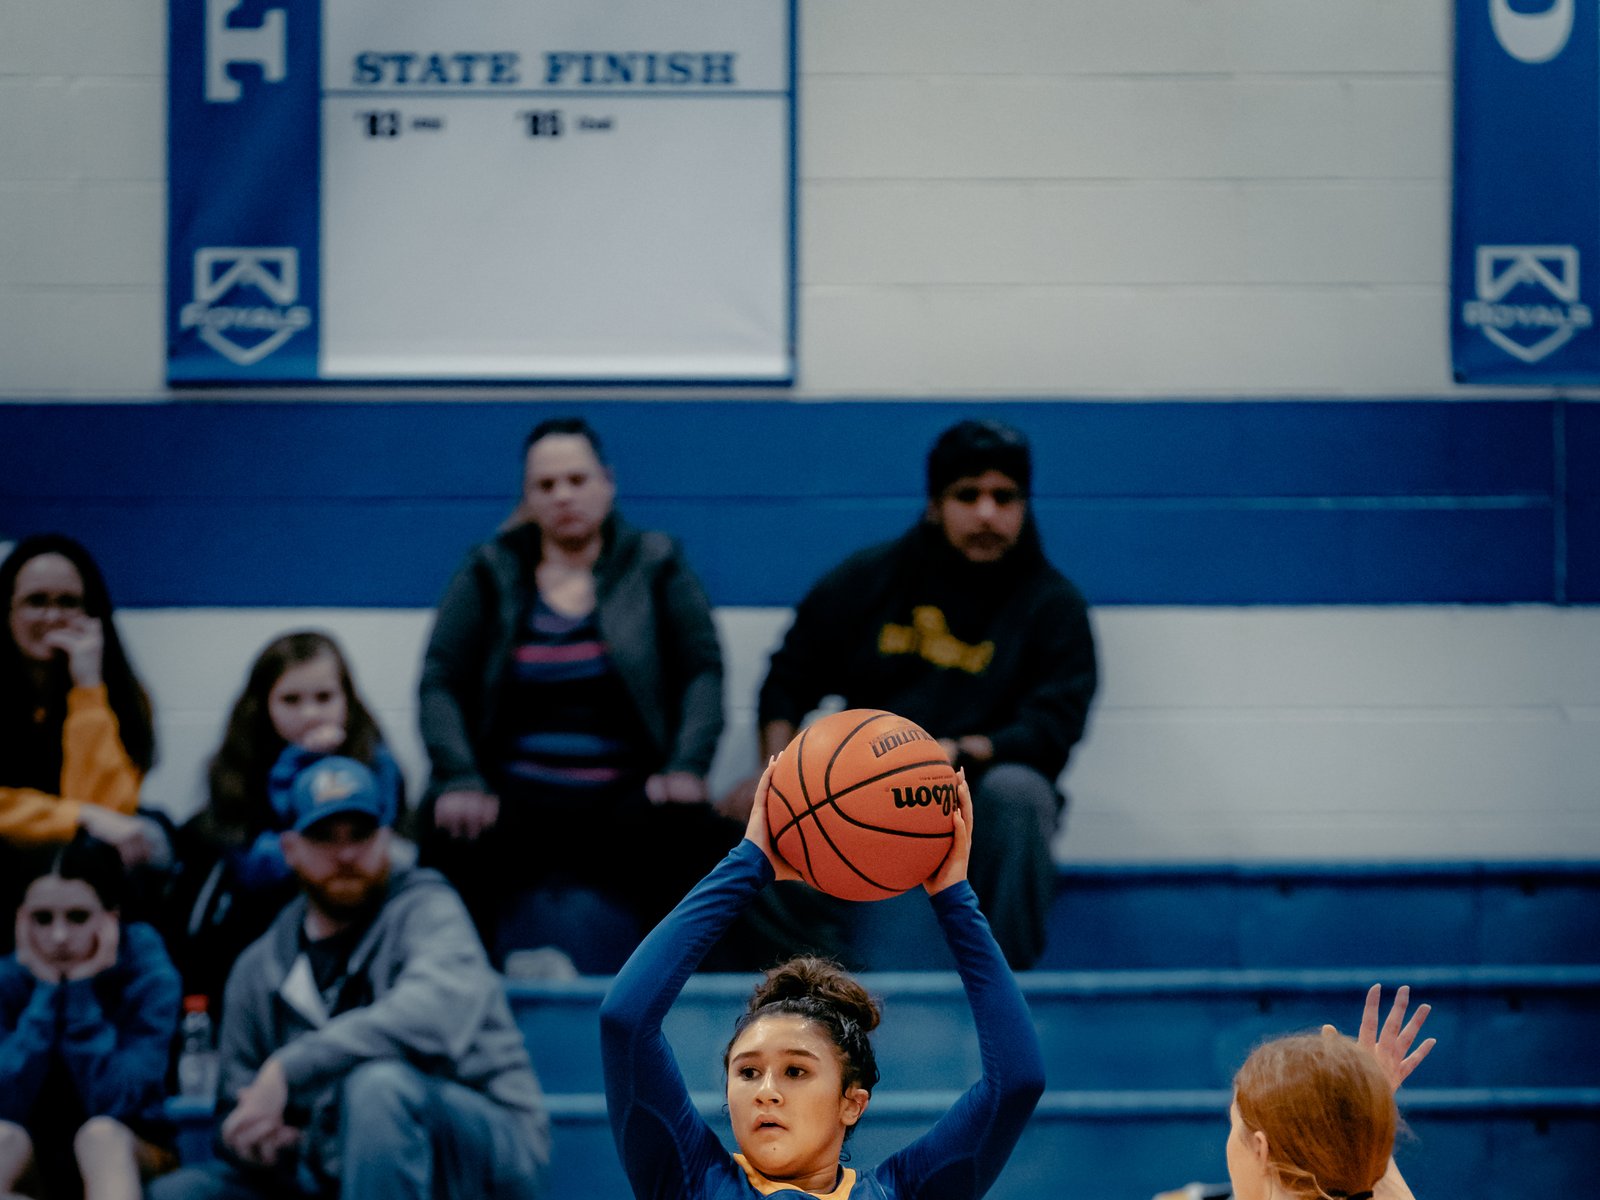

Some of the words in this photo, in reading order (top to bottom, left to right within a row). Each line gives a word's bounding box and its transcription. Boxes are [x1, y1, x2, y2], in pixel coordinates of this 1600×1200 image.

[353, 51, 521, 85] STATE
[542, 51, 739, 85] FINISH
[891, 783, 960, 816] ilson
